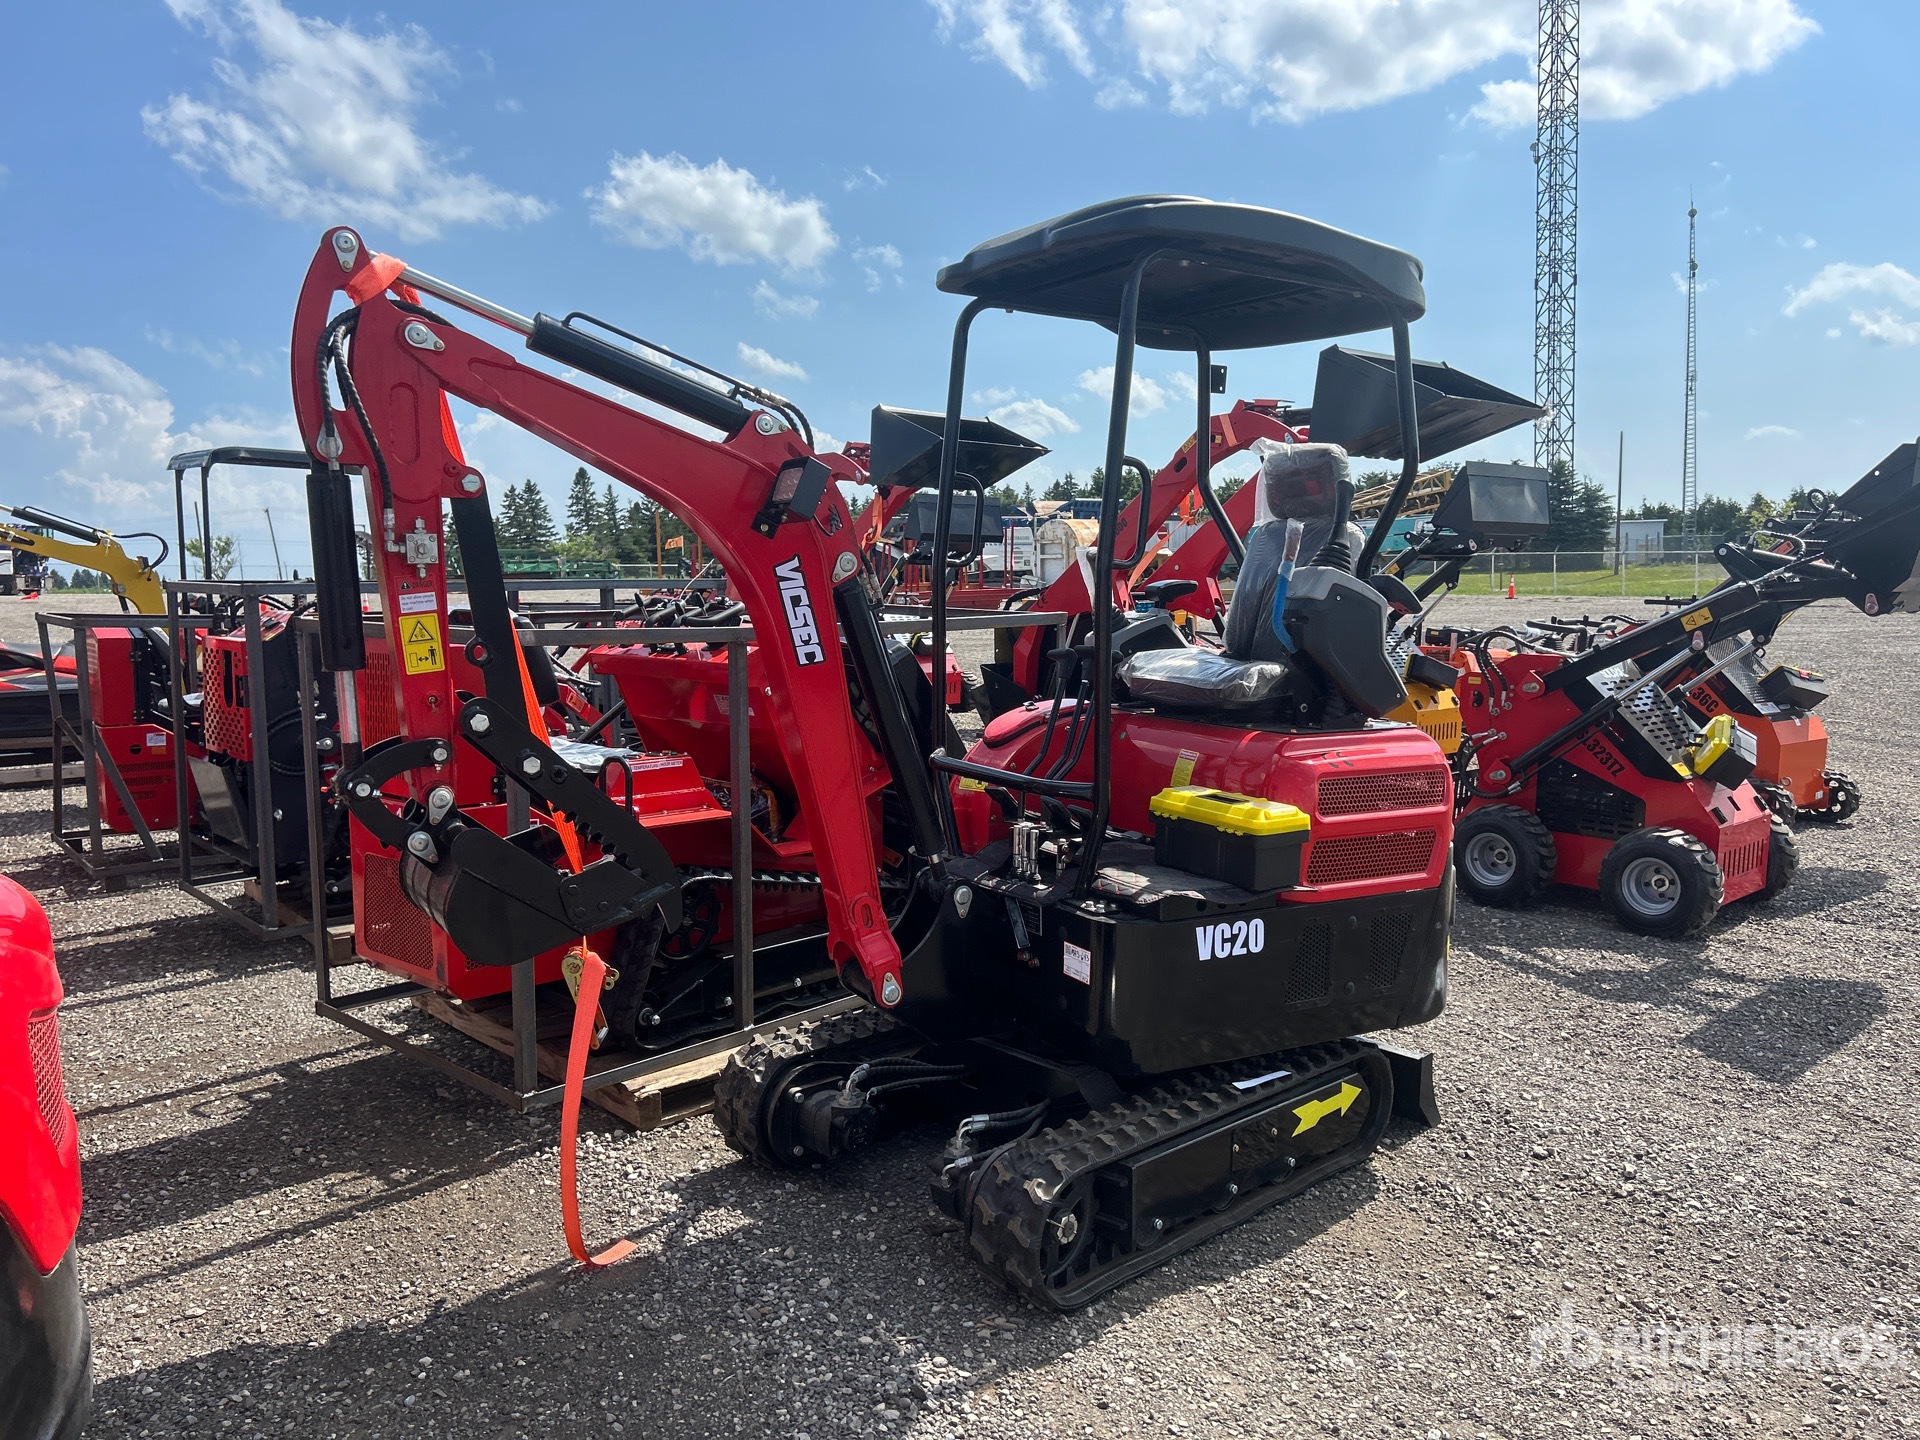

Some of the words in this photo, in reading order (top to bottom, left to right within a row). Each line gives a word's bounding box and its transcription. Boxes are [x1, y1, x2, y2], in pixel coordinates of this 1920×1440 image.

[413, 580, 432, 588] DANGER
[774, 555, 825, 666] VICSEC
[1195, 918, 1265, 961] VC20
